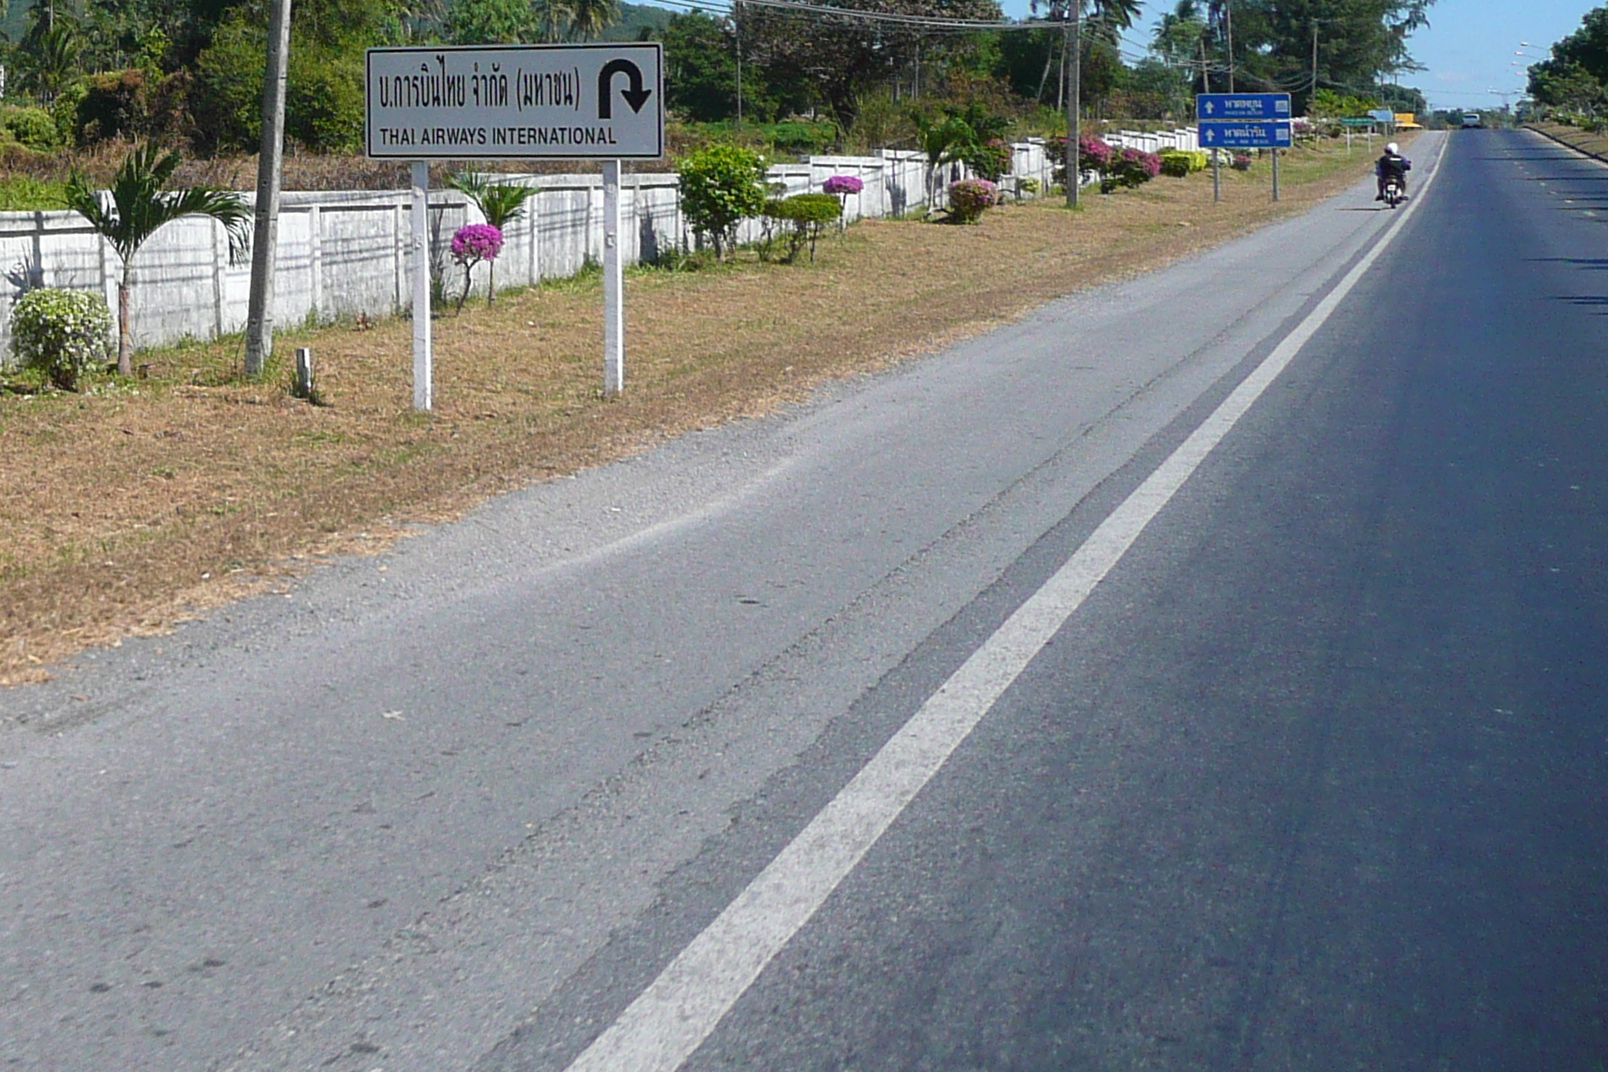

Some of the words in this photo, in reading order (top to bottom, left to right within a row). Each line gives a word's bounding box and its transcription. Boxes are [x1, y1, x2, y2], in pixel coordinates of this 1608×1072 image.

[379, 54, 466, 107] บ.การบินไทย
[471, 61, 508, 107] จำกัด
[516, 66, 580, 112] (มหาชน)
[379, 127, 415, 145] THAI
[420, 127, 487, 145] AIRWAYS
[492, 126, 617, 145] INTERNATIONAL
